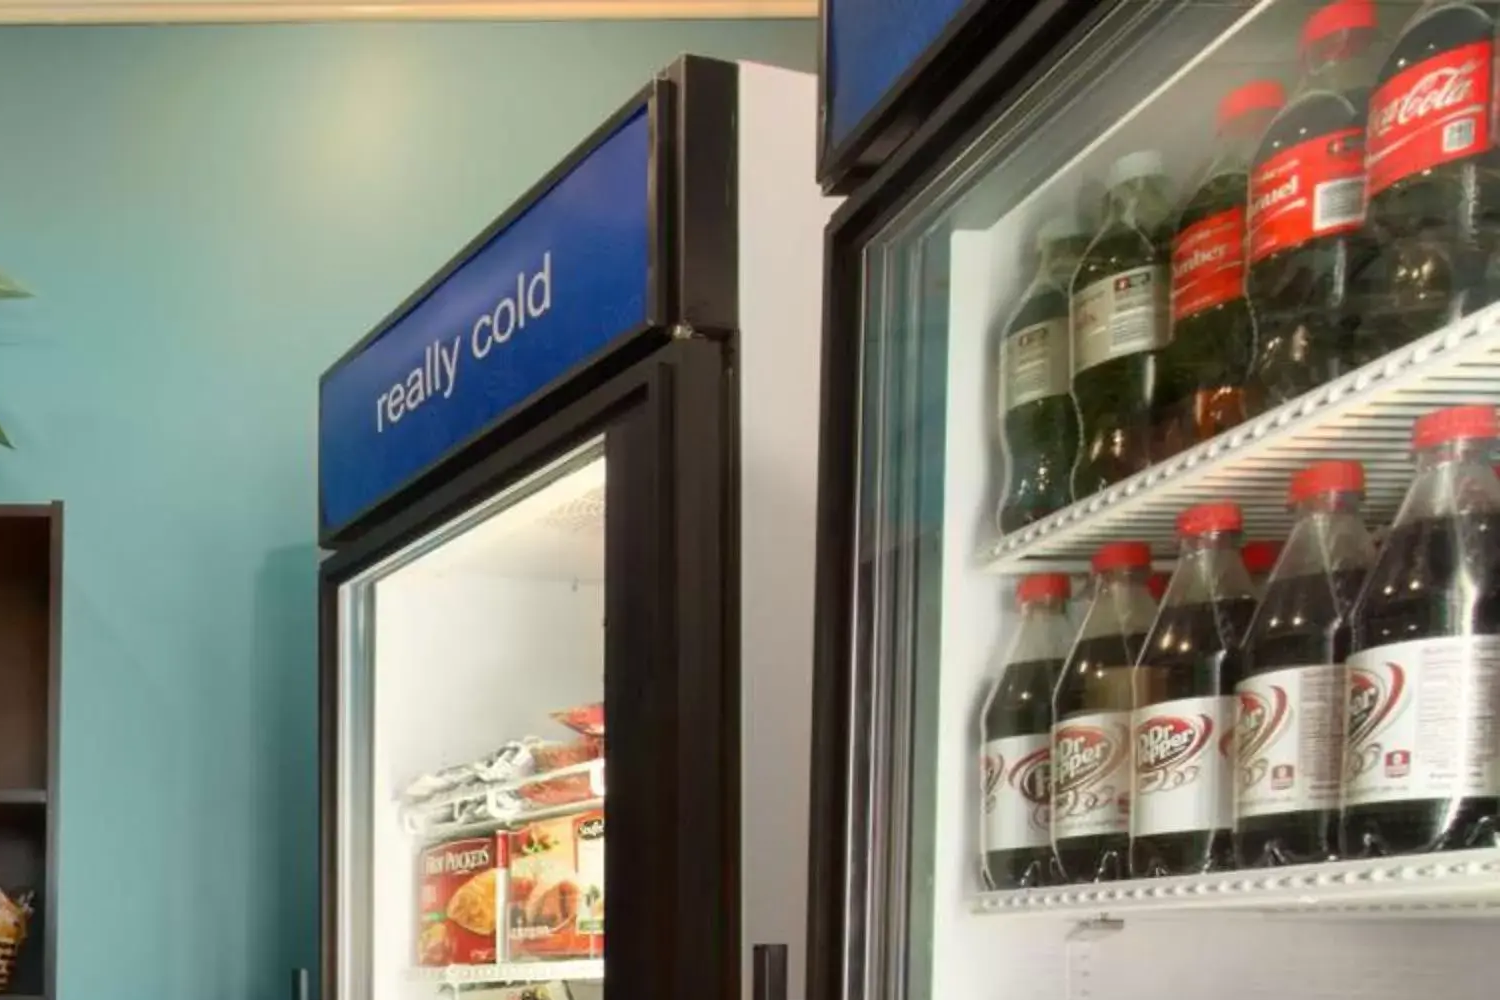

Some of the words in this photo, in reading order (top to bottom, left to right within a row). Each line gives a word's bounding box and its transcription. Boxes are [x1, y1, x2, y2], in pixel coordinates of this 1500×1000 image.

[376, 335, 461, 433] really
[471, 251, 551, 359] cold
[1059, 736, 1087, 760] Dr
